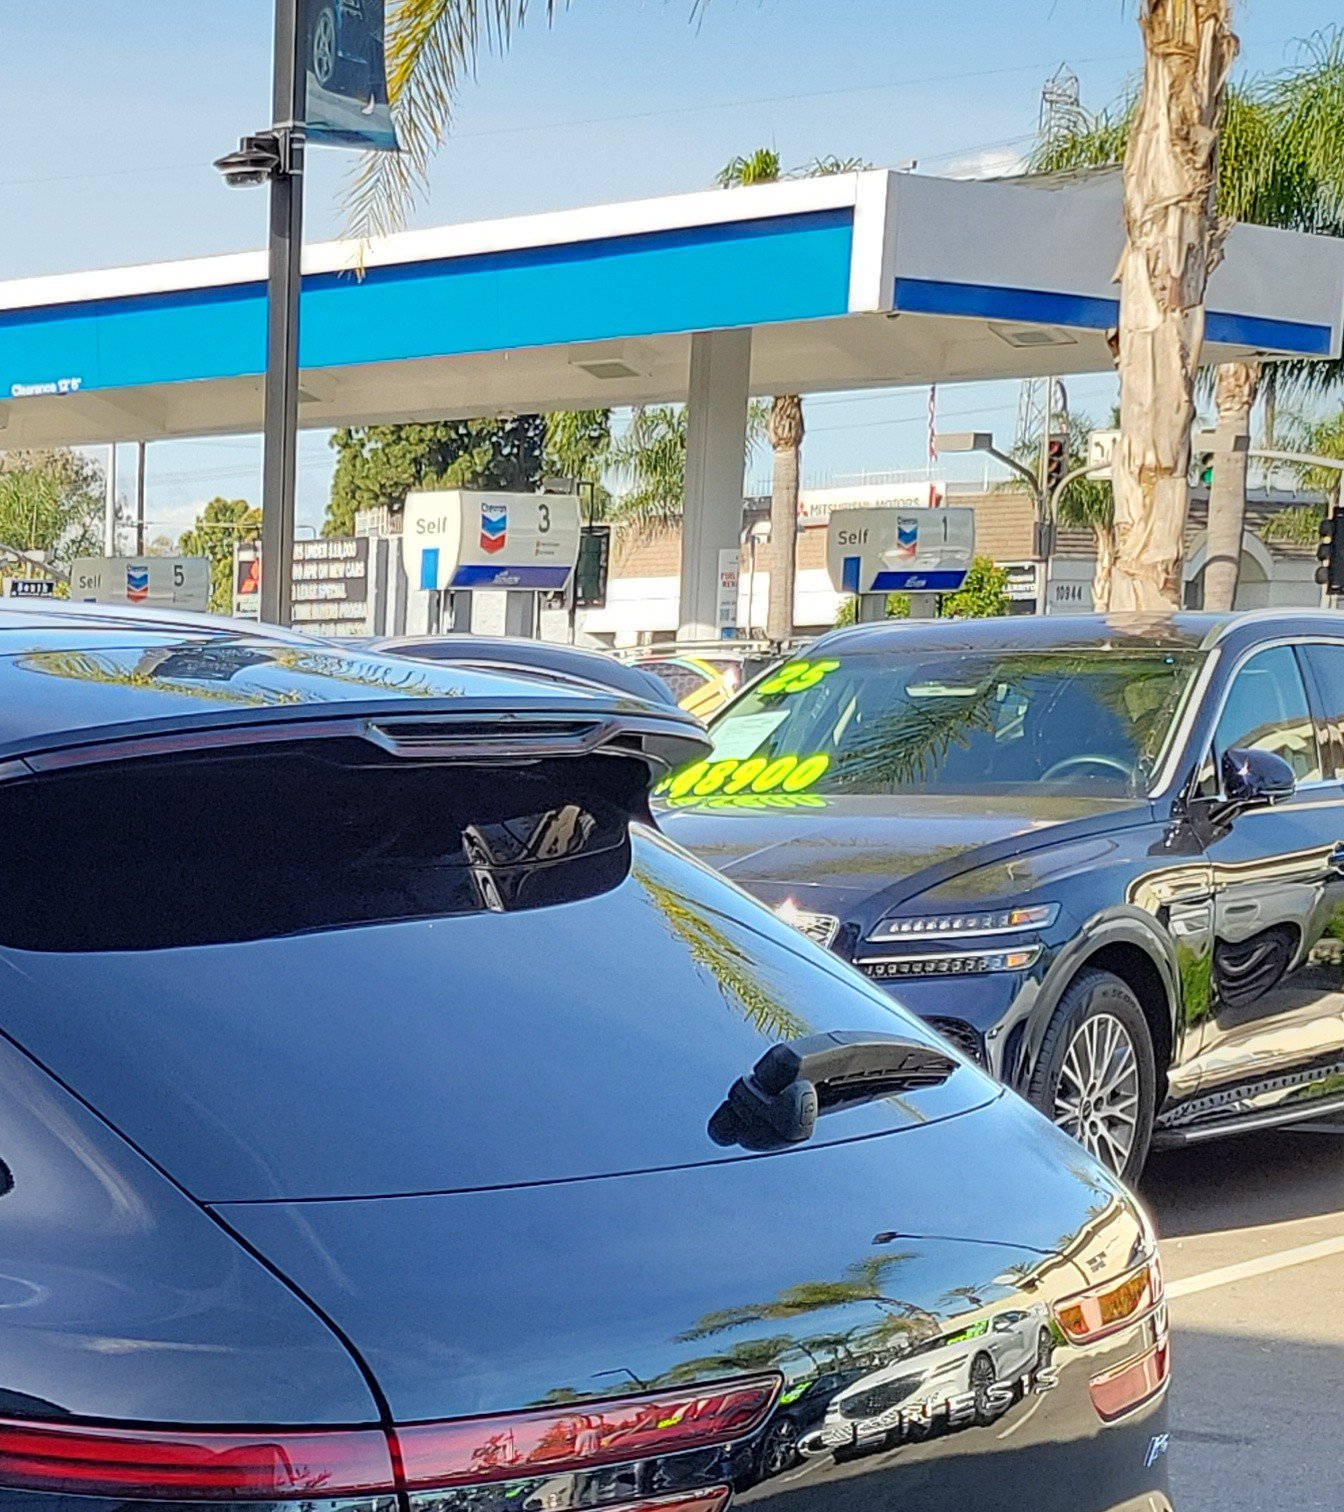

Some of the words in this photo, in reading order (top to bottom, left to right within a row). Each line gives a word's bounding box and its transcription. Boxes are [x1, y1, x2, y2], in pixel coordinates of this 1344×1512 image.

[481, 502, 506, 512] Chevron
[416, 517, 447, 534] Self
[538, 504, 551, 533] 3
[837, 529, 869, 545] Self
[942, 516, 948, 542] 1
[79, 575, 102, 590] Self
[174, 564, 186, 587] 5
[756, 661, 840, 695] 25
